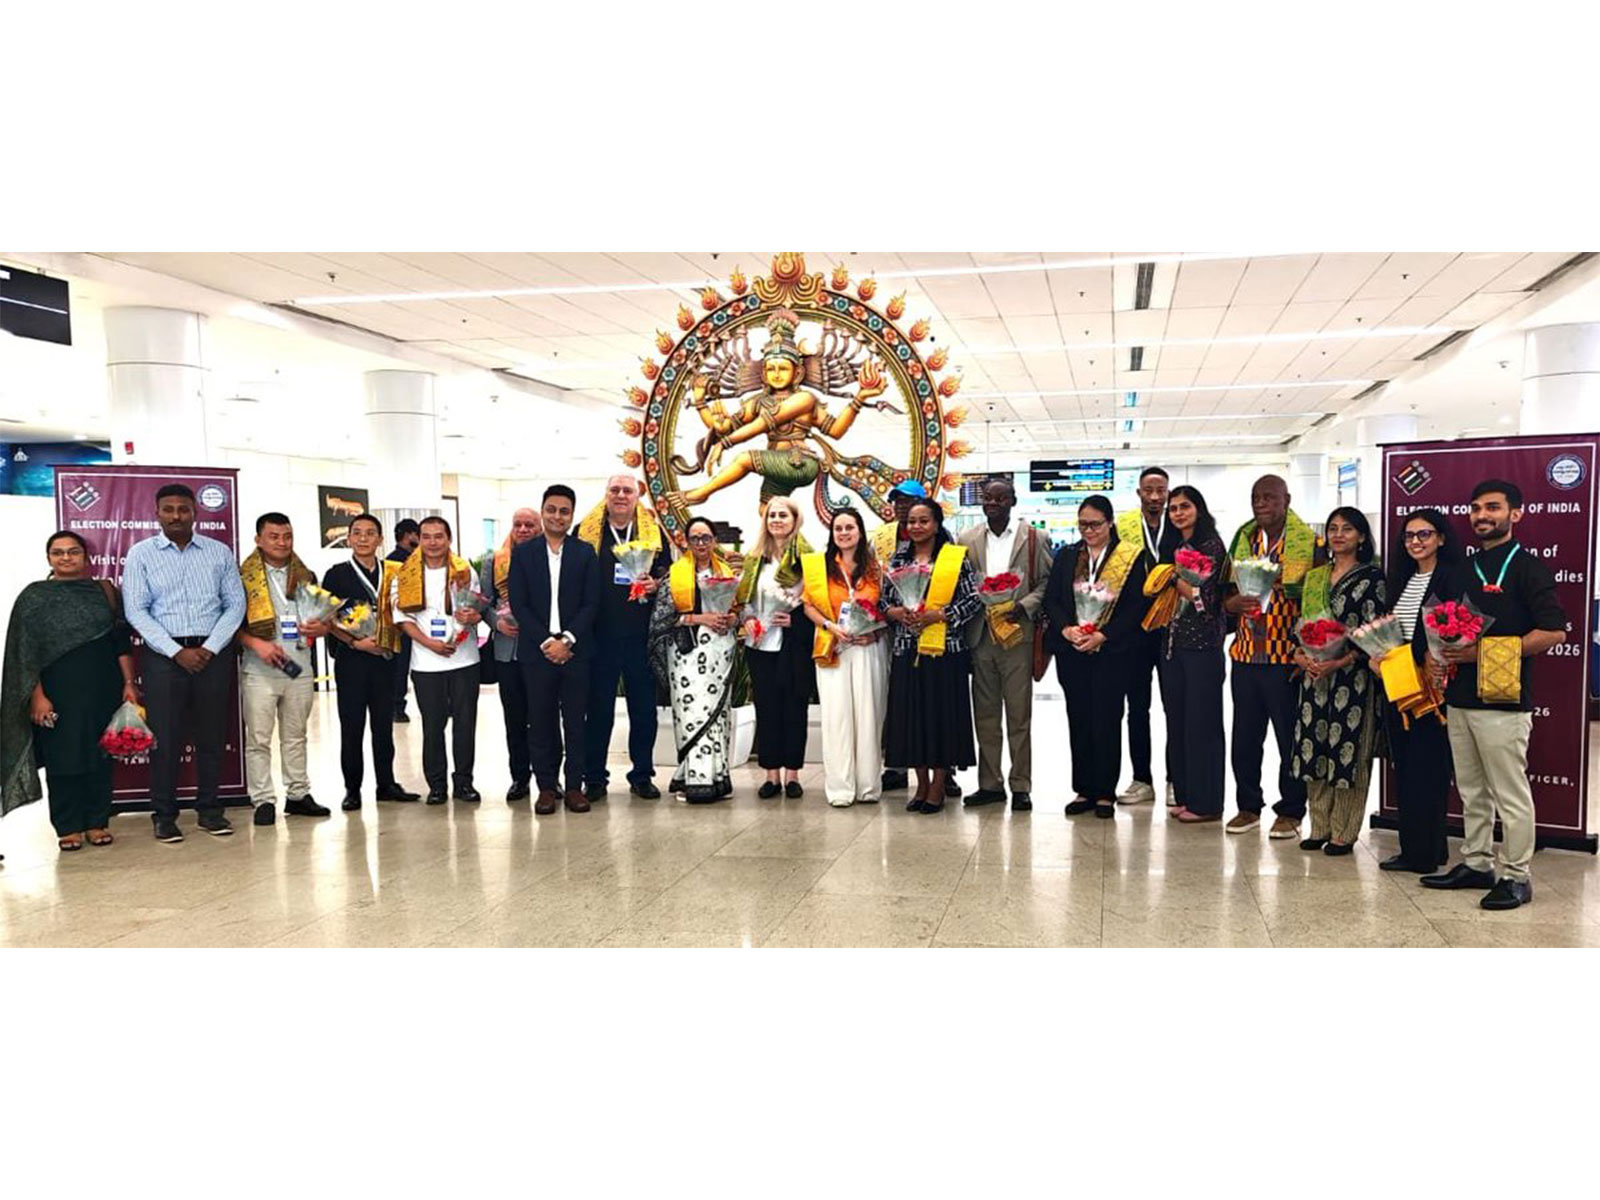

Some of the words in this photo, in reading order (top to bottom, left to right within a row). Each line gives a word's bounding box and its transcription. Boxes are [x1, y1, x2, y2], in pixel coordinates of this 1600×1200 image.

[1528, 503, 1544, 514] OF
[1547, 502, 1581, 513] INDIA
[70, 520, 119, 529] ELECTION
[121, 520, 160, 530] COMMIS
[199, 521, 226, 530] INDIA
[1542, 544, 1558, 558] of
[90, 554, 117, 566] Visit
[1546, 643, 1580, 656] 2026
